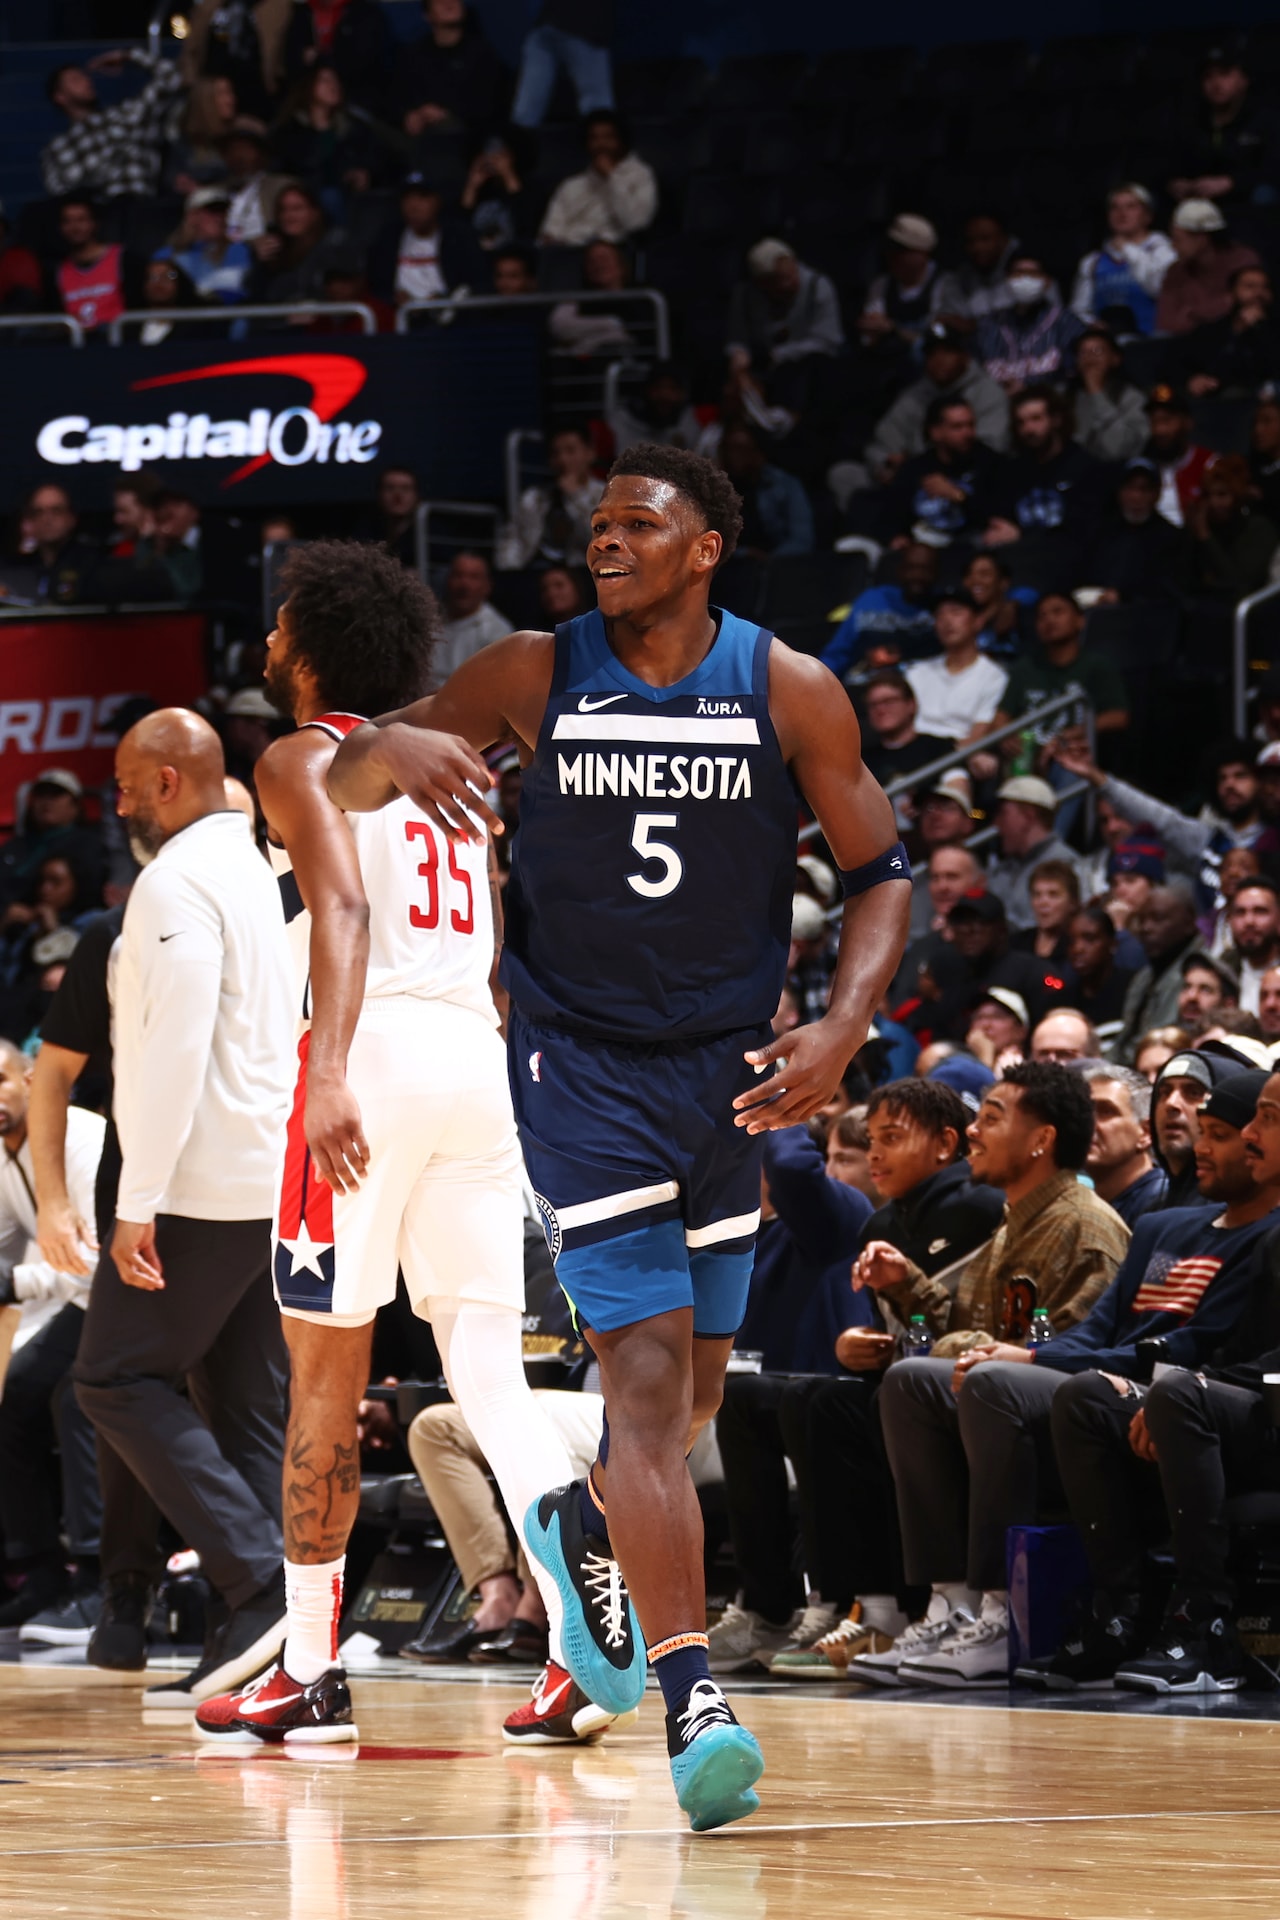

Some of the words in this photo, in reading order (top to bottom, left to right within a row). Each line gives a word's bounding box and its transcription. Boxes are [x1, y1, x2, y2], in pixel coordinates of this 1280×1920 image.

[557, 753, 752, 800] MINNESOTA
[405, 820, 474, 935] 35
[625, 812, 684, 899] 5
